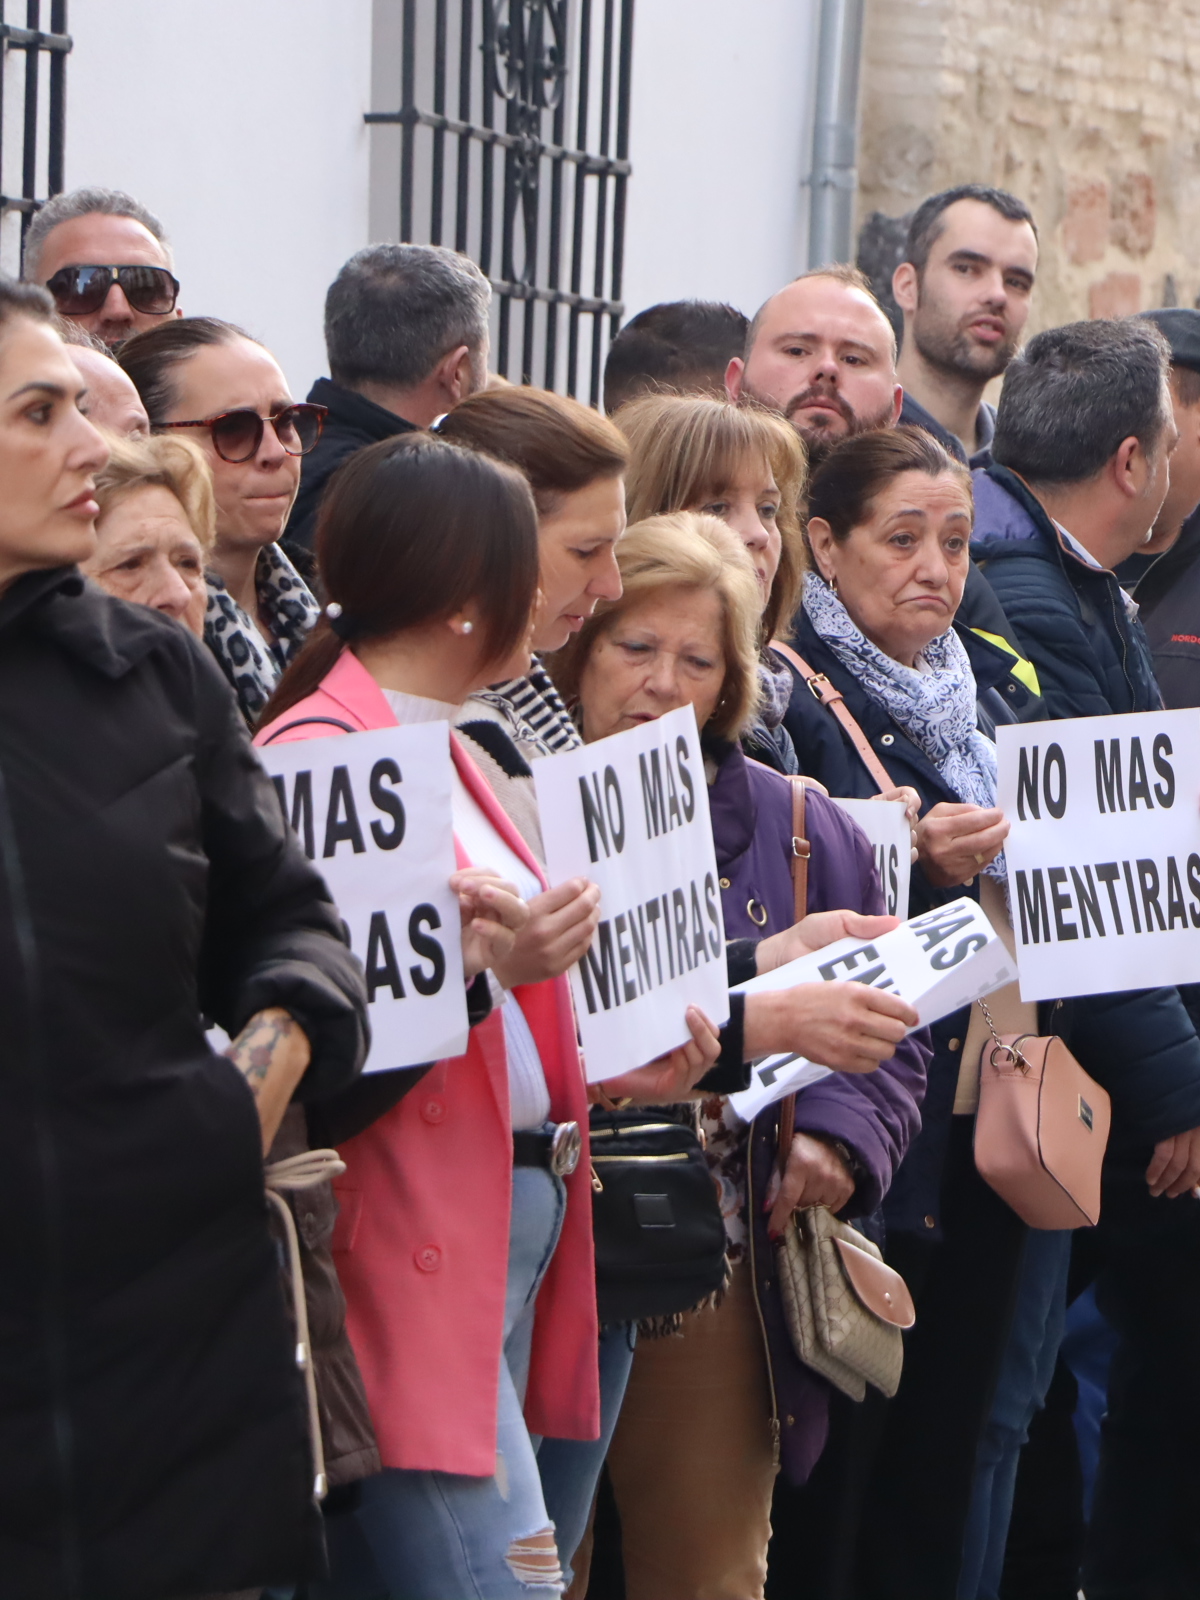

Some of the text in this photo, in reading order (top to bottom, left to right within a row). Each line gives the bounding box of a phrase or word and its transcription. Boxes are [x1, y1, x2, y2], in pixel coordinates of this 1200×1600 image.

[578, 735, 696, 863] NO MAS
[1017, 733, 1176, 821] NO MAS
[341, 903, 447, 1004] AS
[577, 871, 722, 1014] MENTIRAS
